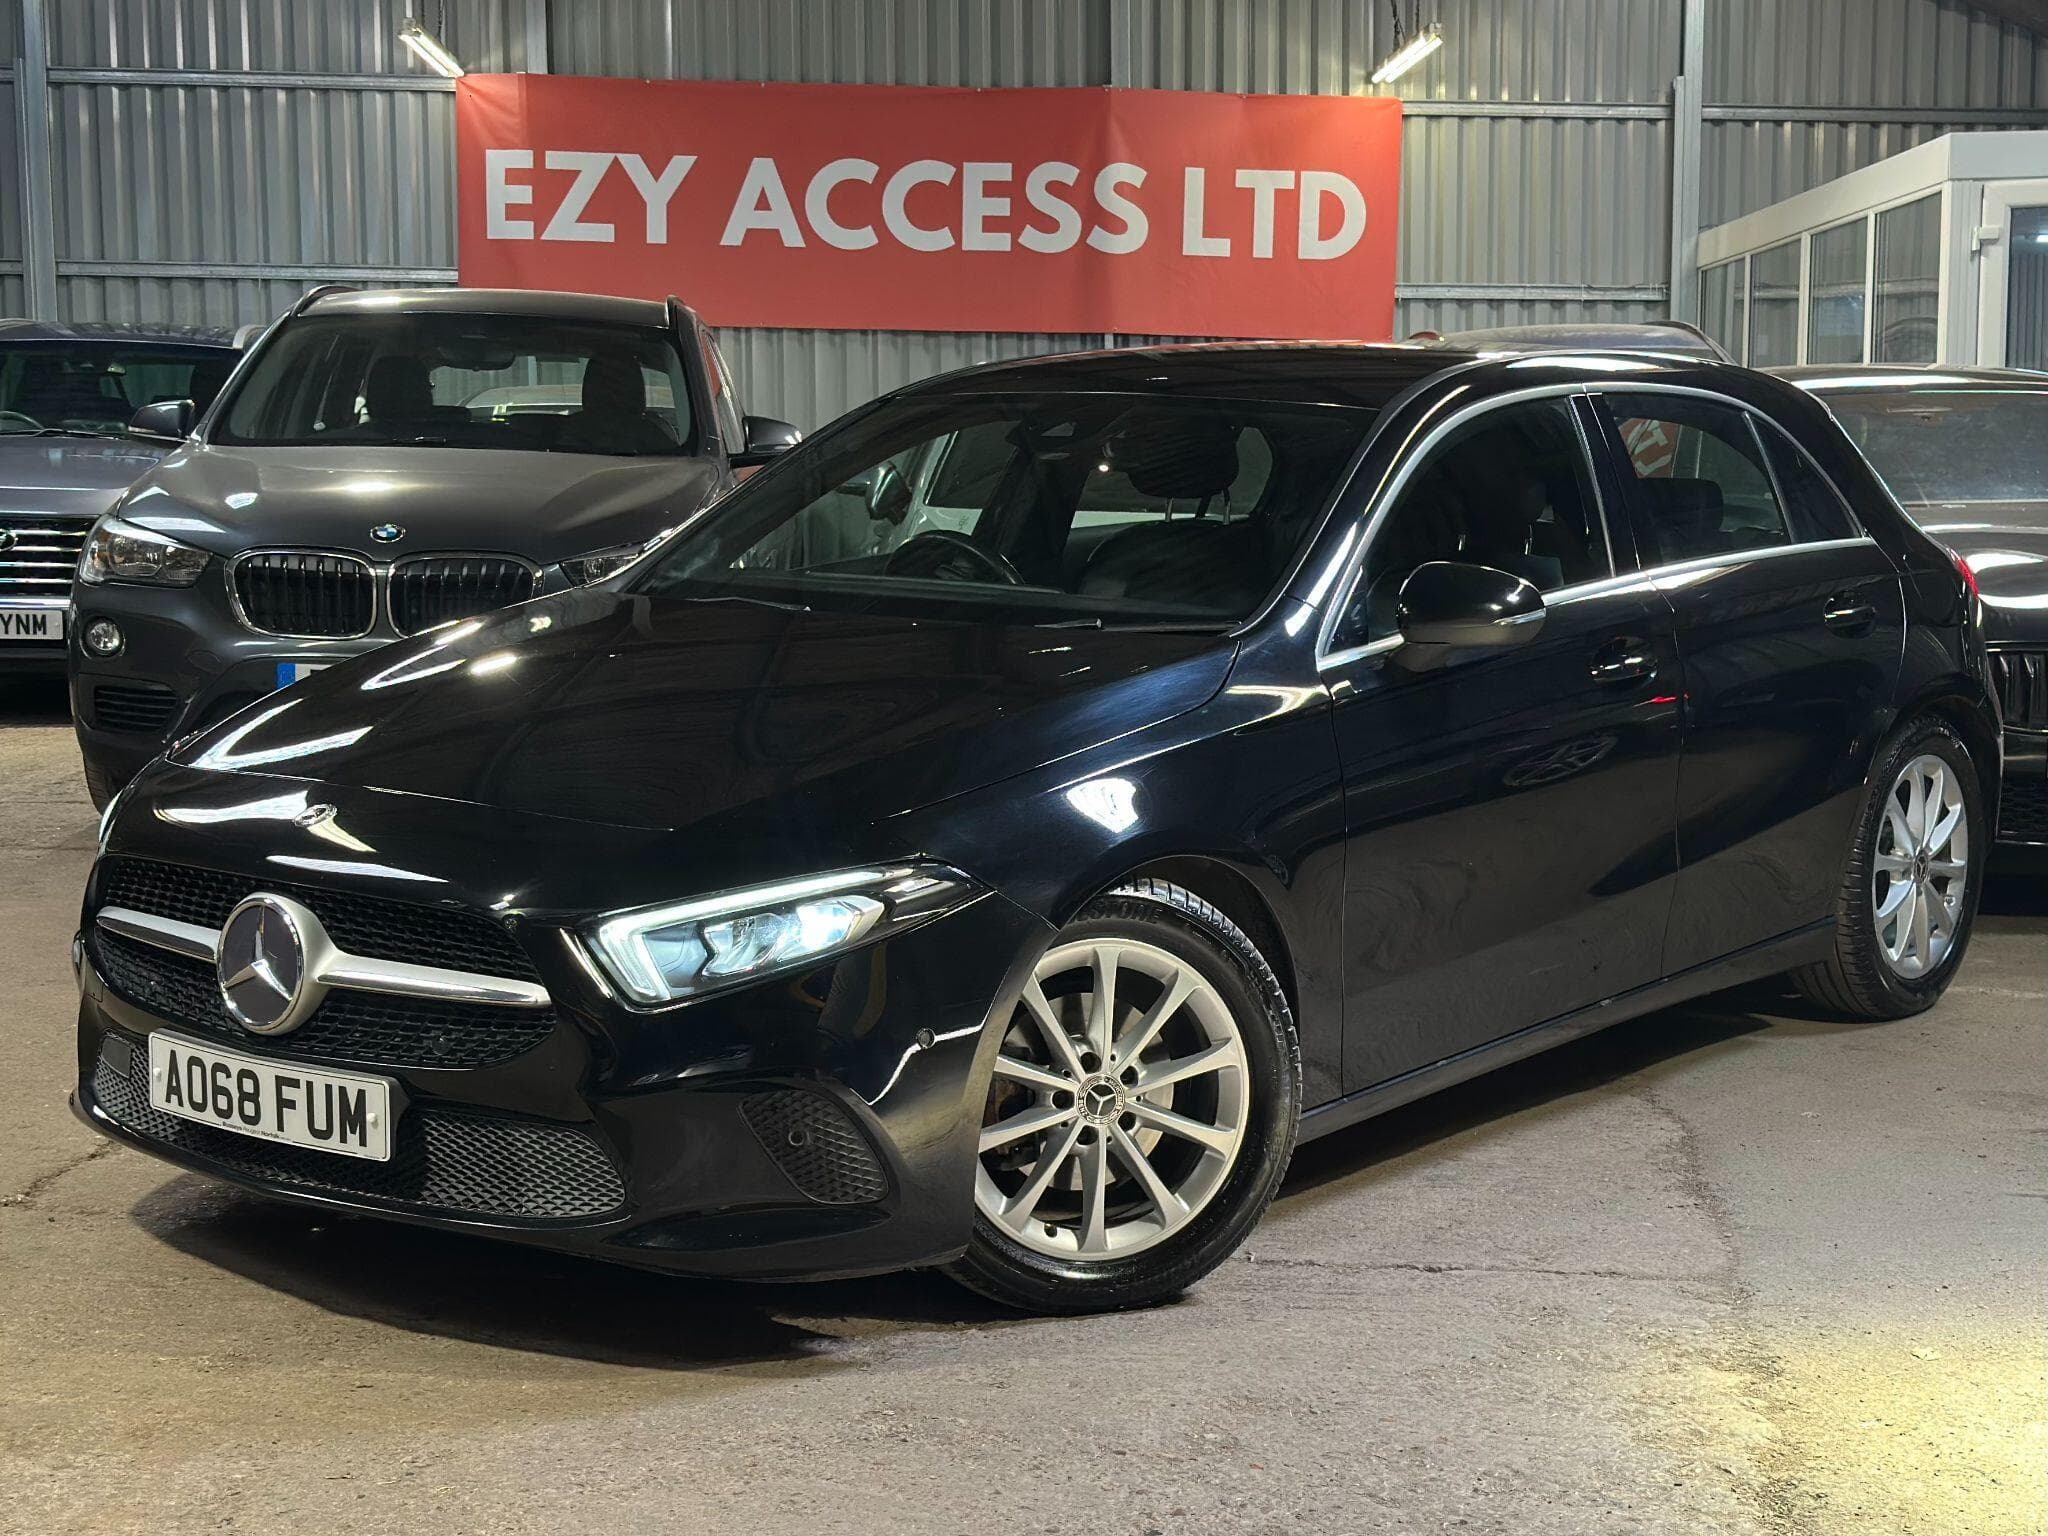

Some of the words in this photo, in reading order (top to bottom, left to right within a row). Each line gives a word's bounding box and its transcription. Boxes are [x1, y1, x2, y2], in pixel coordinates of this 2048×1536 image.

[486, 149, 697, 244] EZY
[720, 157, 1148, 255] ACCESS
[1183, 167, 1367, 260] LTD
[0, 613, 47, 635] YNM
[165, 1049, 262, 1127] AO68
[275, 1074, 368, 1148] FUM
